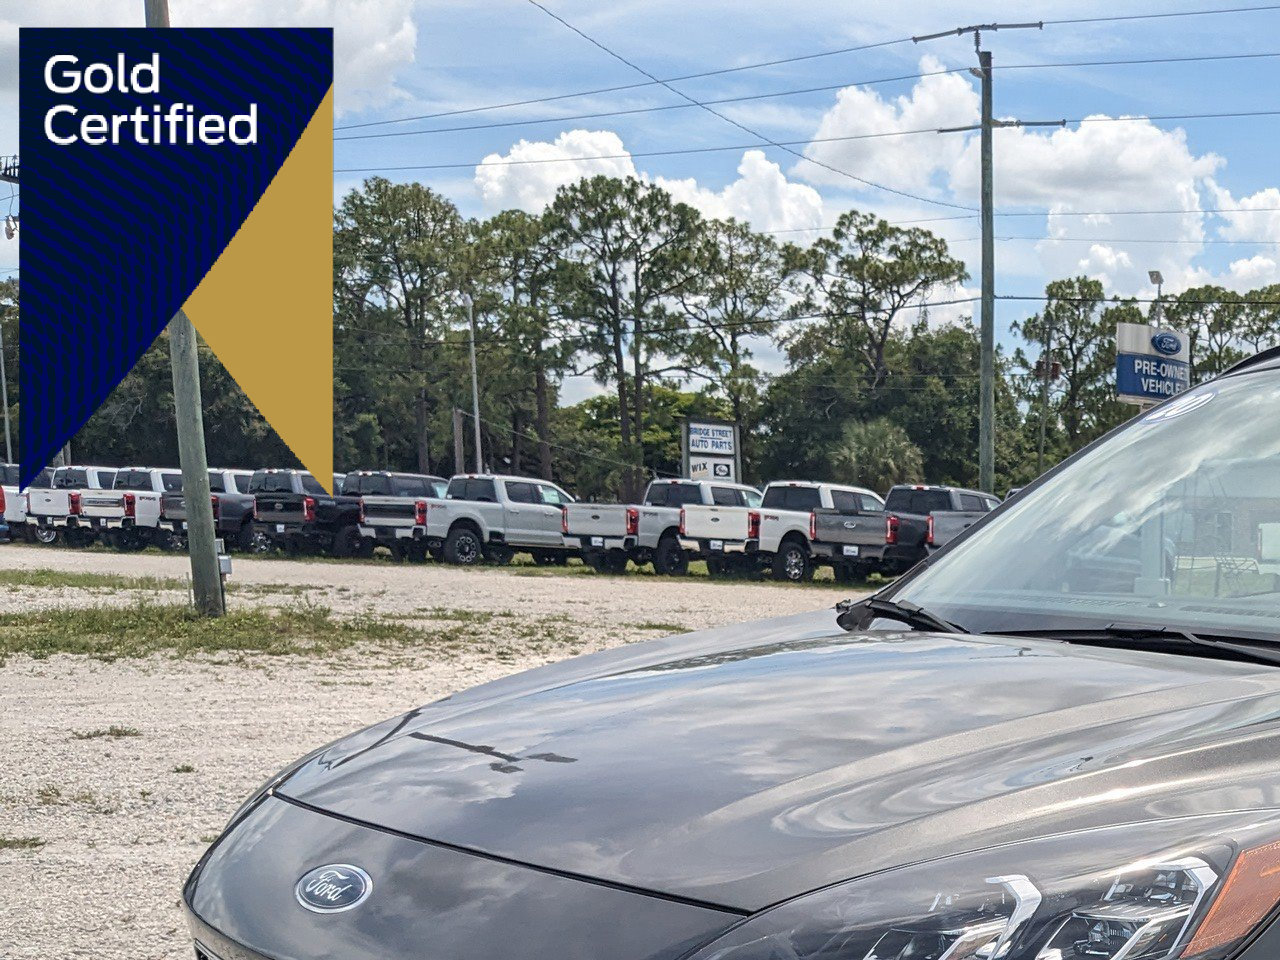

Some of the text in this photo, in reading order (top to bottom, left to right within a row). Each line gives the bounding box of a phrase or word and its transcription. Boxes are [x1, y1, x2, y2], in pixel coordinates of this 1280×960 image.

[1160, 337, 1178, 350] Ford
[690, 427, 732, 438] BRIDGE STREET
[691, 439, 732, 451] AUTO PARTS
[691, 461, 708, 474] WIX
[305, 870, 352, 902] Ford
